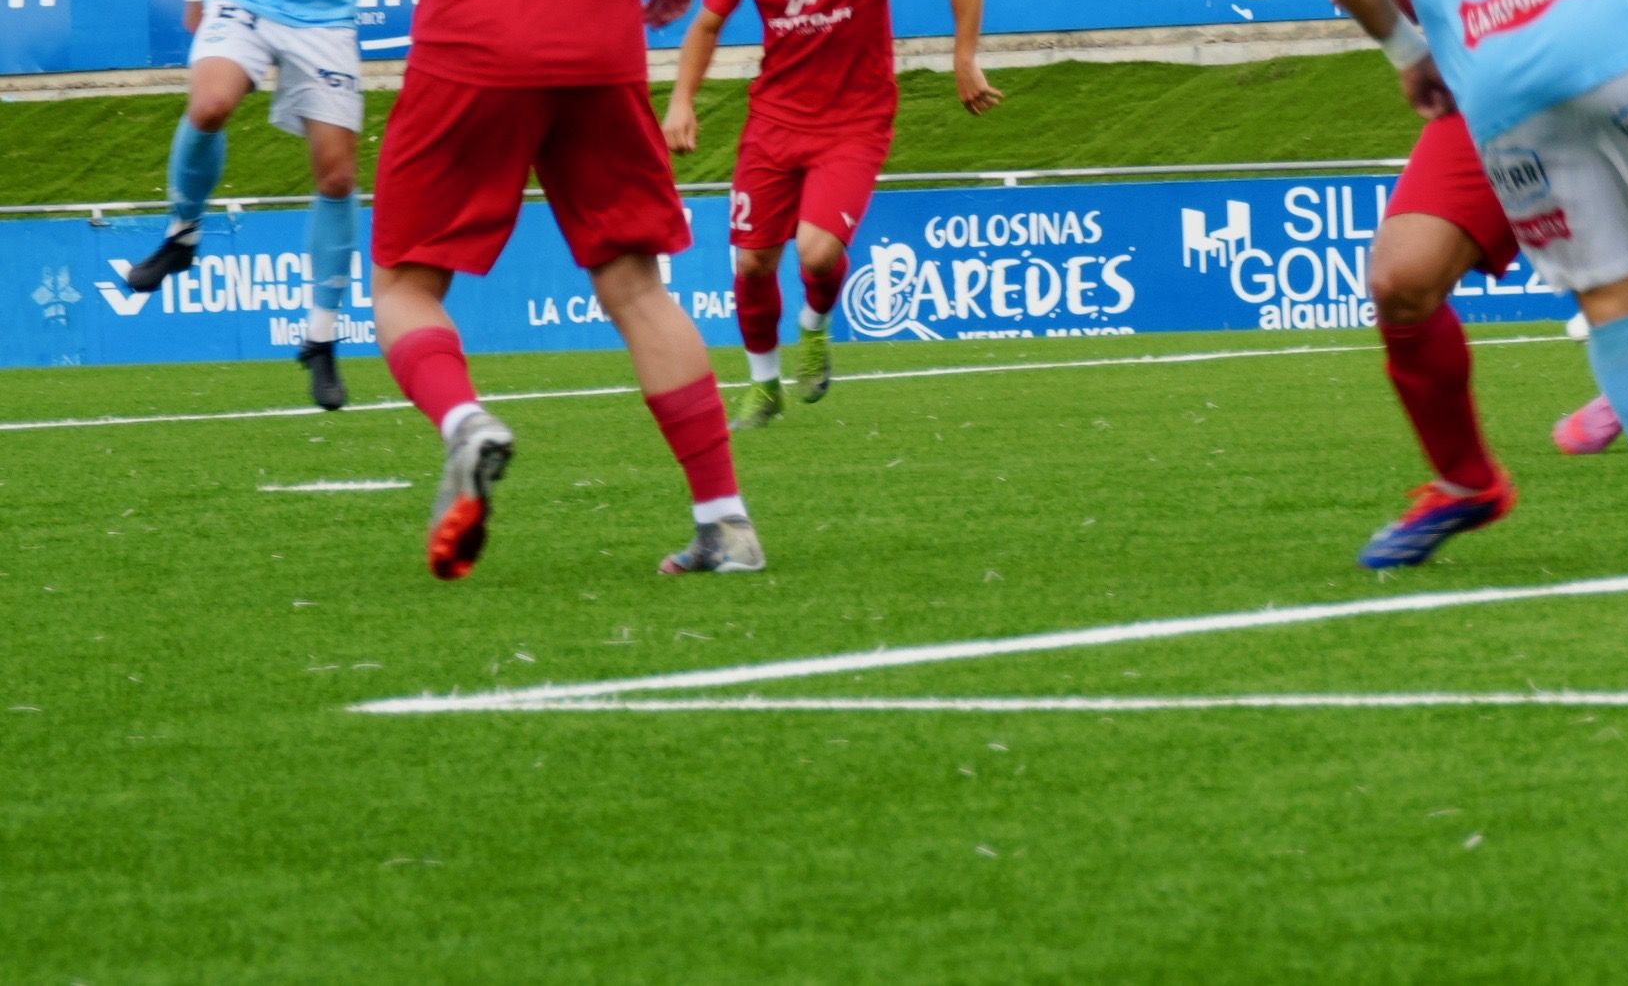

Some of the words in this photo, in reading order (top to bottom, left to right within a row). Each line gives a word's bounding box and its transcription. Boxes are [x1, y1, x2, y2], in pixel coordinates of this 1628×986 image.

[924, 210, 1102, 248] GOLOSINAS
[869, 242, 1136, 323] PAREDES
[528, 297, 560, 325] LA
[567, 295, 612, 323] CA
[693, 291, 738, 319] PAP
[1259, 295, 1378, 330] alquile
